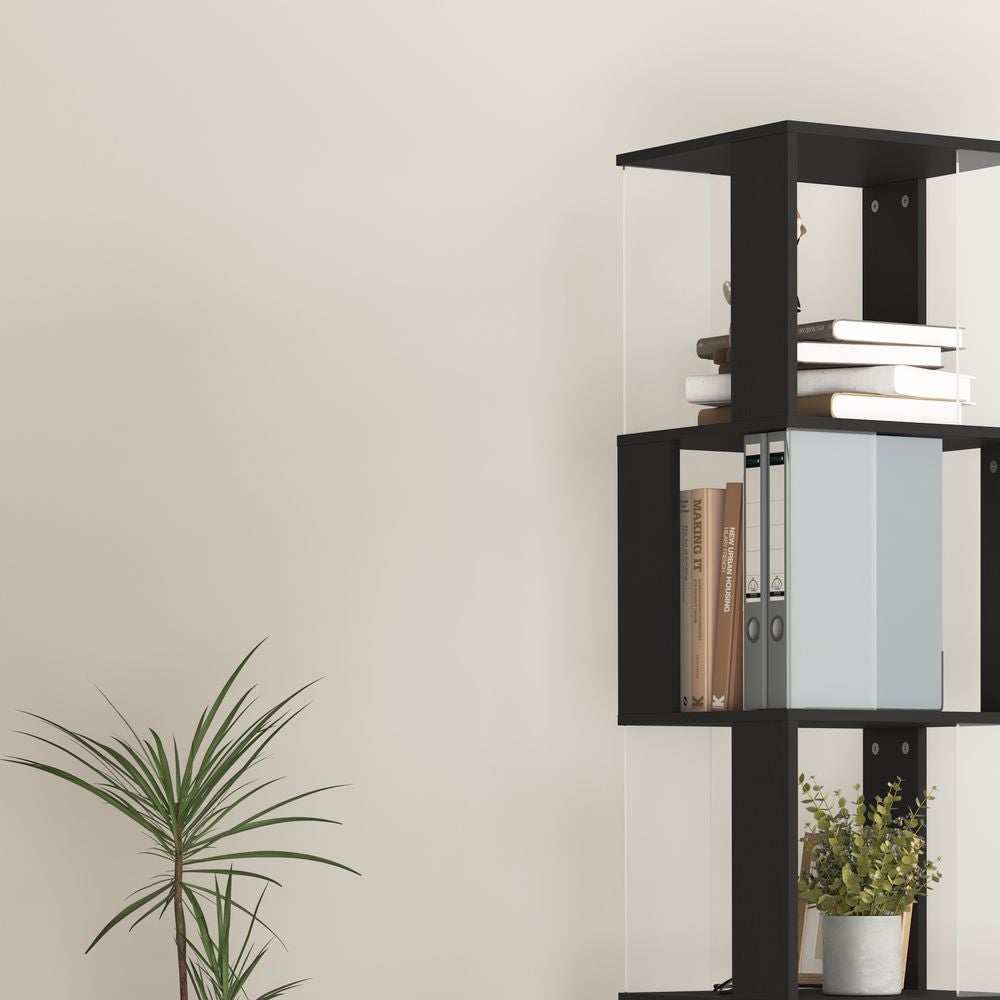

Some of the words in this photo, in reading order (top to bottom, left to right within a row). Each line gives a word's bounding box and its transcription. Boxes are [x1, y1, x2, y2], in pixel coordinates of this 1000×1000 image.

[693, 499, 702, 555] MAKING
[728, 526, 736, 546] NEW
[693, 557, 702, 573] IT
[726, 546, 735, 575] URBAN
[723, 576, 733, 613] HOUSING
